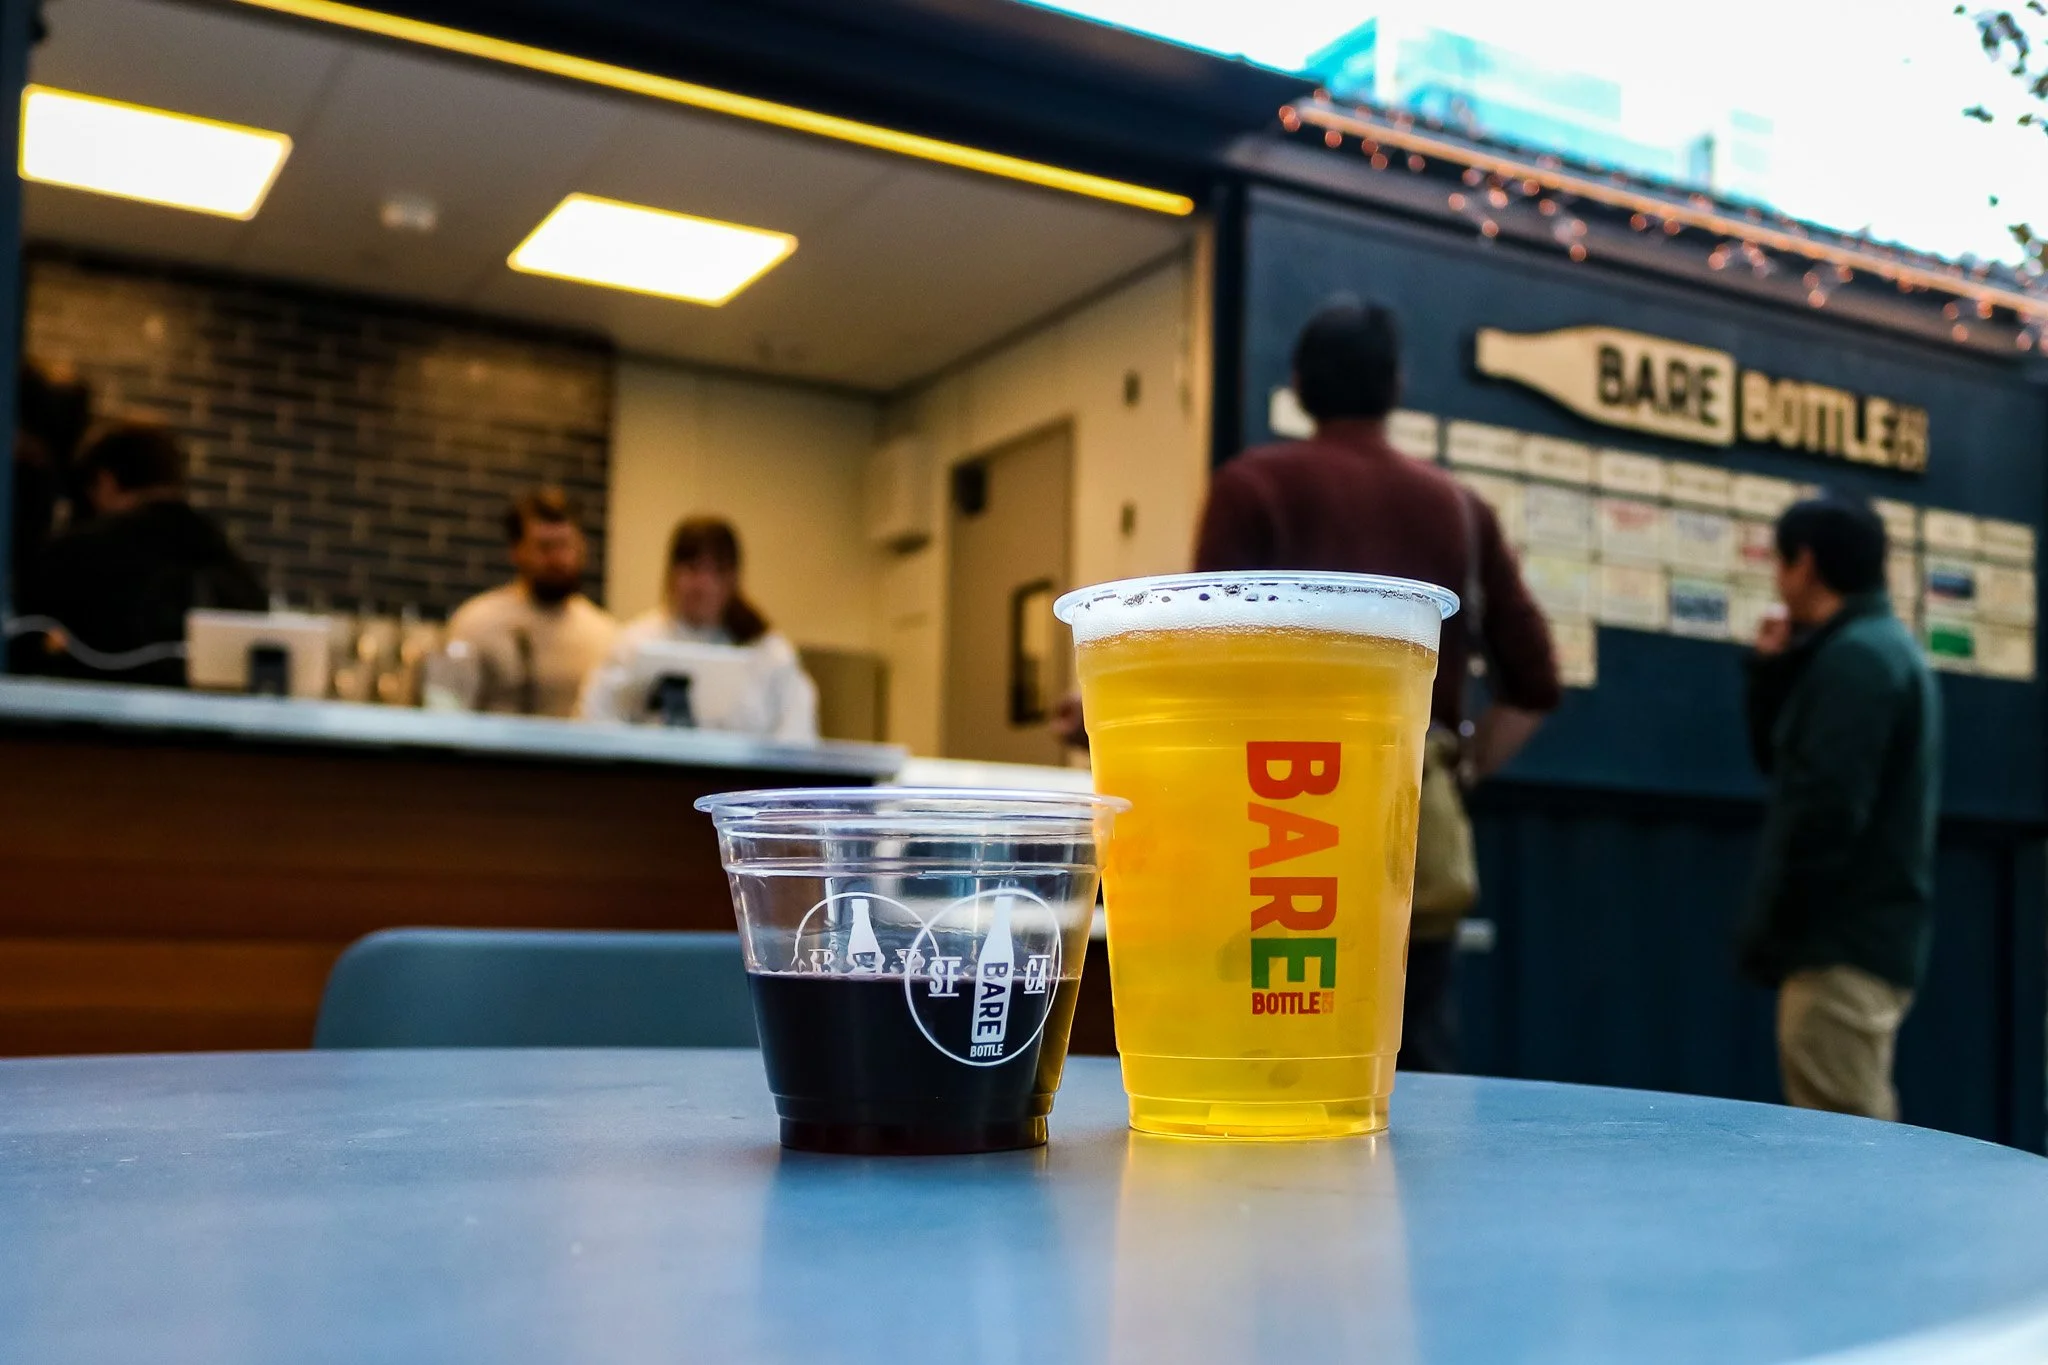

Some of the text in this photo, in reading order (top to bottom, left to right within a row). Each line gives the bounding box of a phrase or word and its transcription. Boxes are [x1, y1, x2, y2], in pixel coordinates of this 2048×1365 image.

[1598, 344, 1723, 428] BARE
[1743, 368, 1896, 466] BOTTLE
[1246, 741, 1341, 989] BARE
[929, 959, 961, 994] SF
[1024, 958, 1047, 992] CA
[976, 962, 1009, 1037] BARE
[1252, 992, 1321, 1015] BOTTLE
[970, 1044, 1004, 1057] BOTTLE
